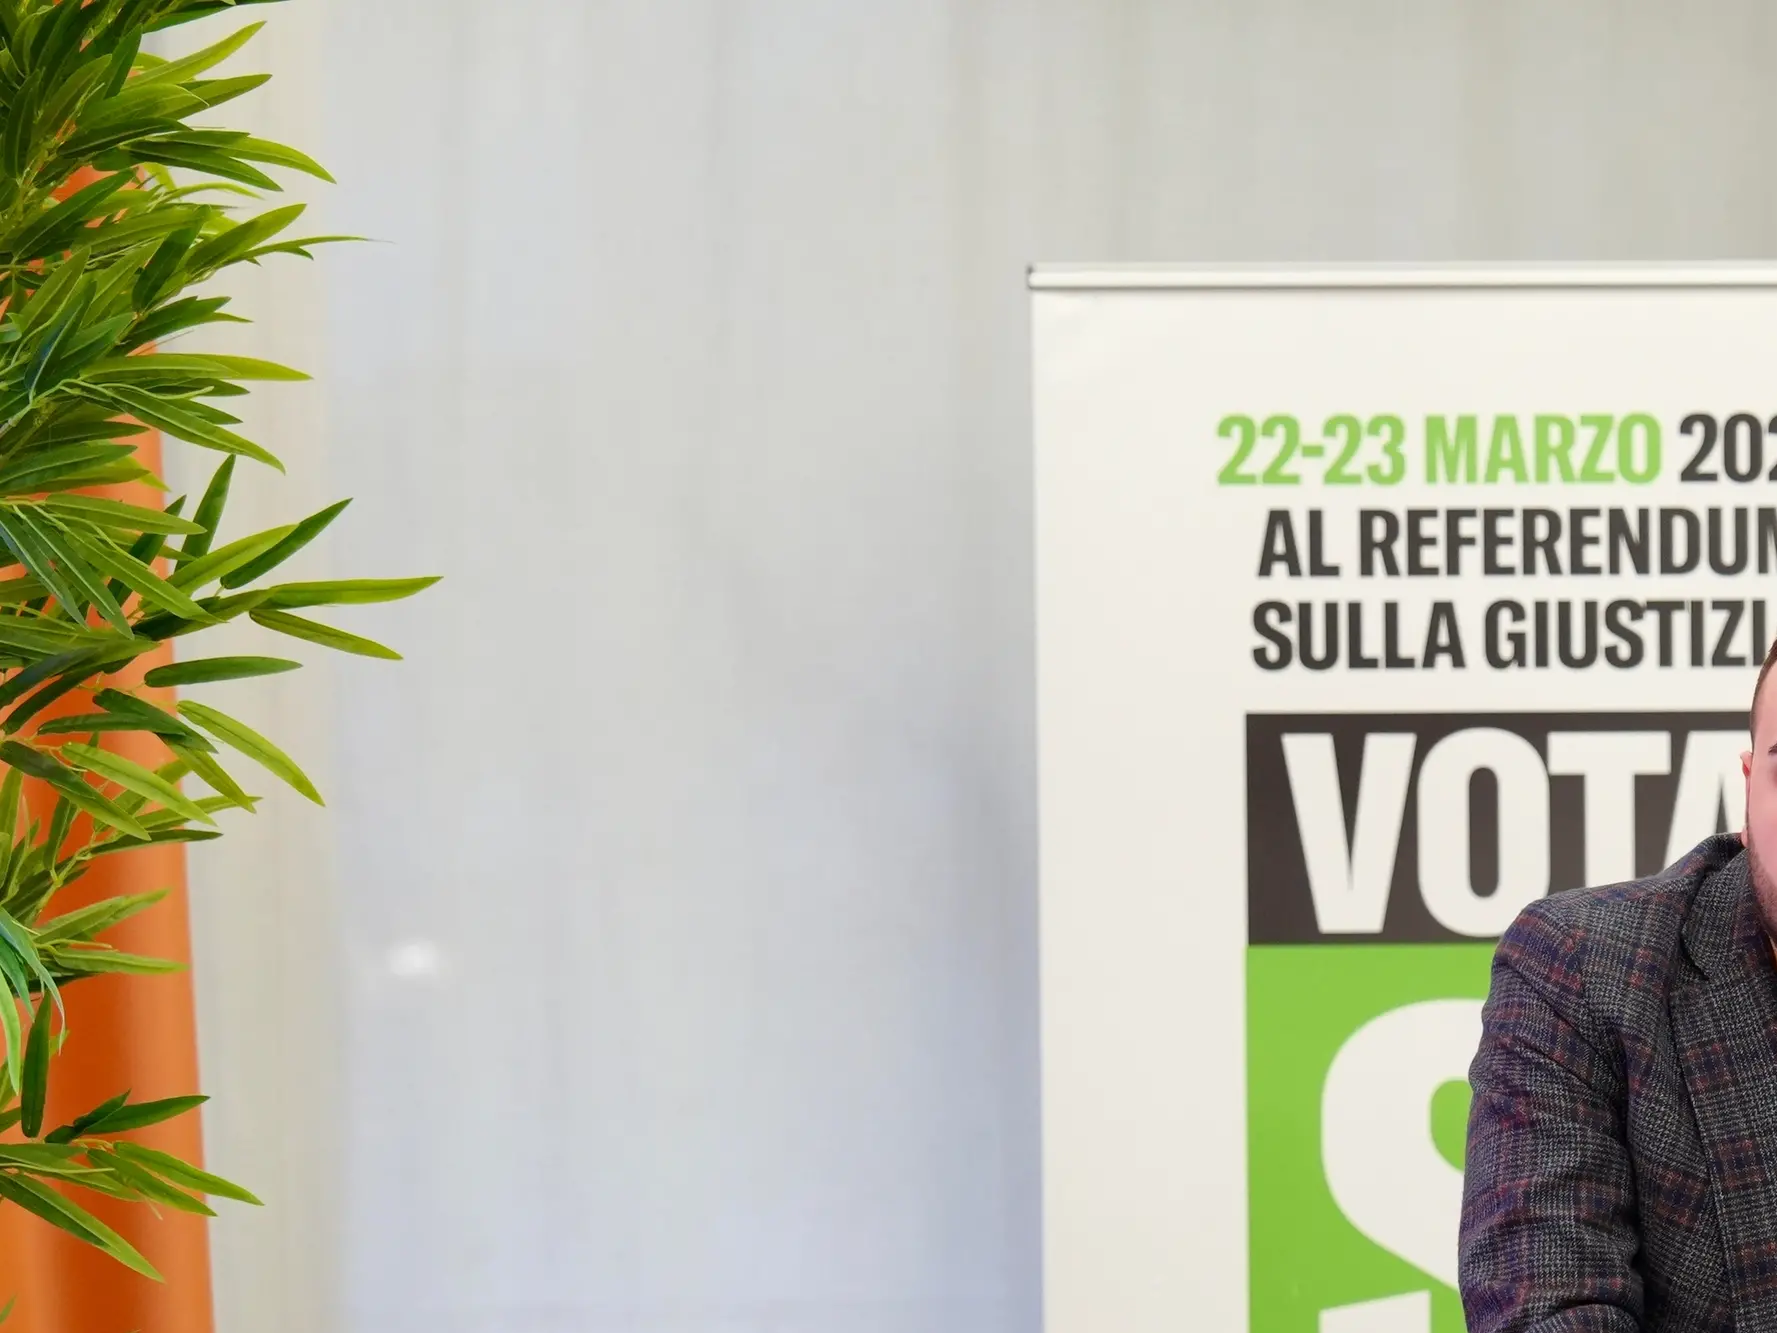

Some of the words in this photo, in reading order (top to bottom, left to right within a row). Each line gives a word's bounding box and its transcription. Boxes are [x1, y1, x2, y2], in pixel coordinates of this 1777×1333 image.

[1217, 413, 1406, 486] 22-23
[1425, 413, 1663, 485] MARZO
[1257, 508, 1341, 578] AL
[1251, 600, 1467, 671] SULLA
